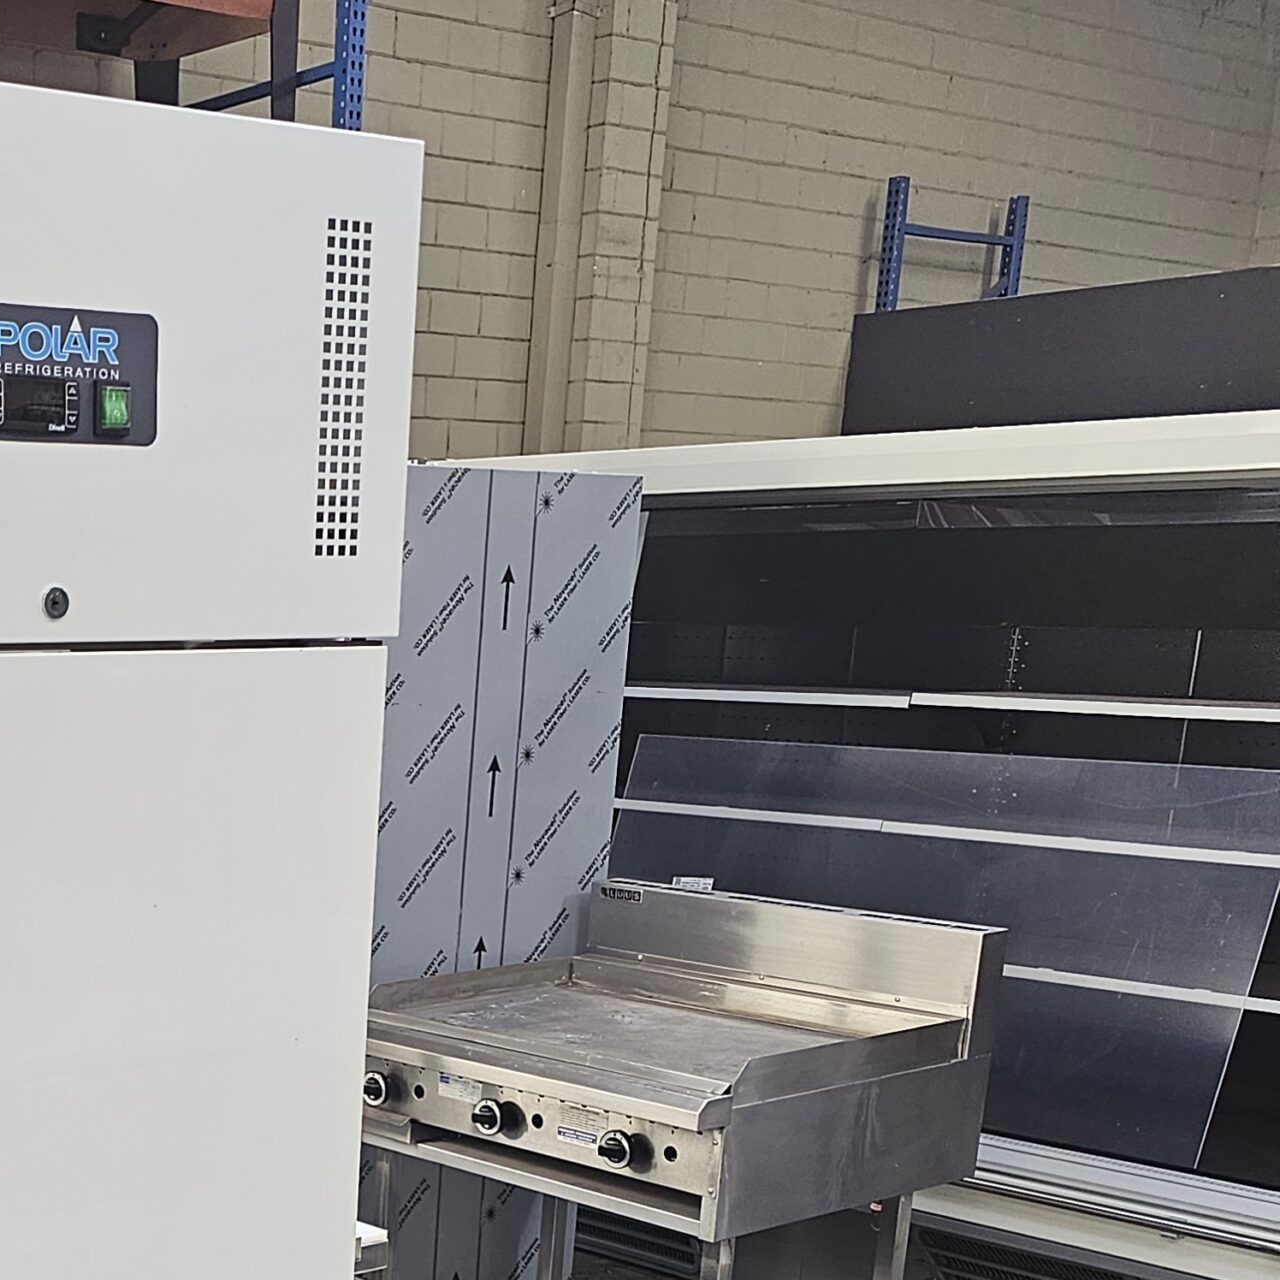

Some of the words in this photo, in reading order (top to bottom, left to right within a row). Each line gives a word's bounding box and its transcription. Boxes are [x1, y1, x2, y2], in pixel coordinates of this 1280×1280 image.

[429, 486, 445, 506] LASER
[448, 582, 463, 602] LASER
[553, 596, 567, 615] LASER
[579, 560, 592, 579] LASER
[421, 619, 436, 639] LASER
[439, 711, 455, 730] LASER
[543, 720, 557, 739] LASER
[568, 684, 582, 703] LASER
[412, 747, 428, 767] LASER
[534, 840, 547, 859] LASER
[559, 805, 572, 824] LASER
[431, 836, 445, 855] LASER
[404, 872, 419, 891] LASER
[609, 888, 641, 902] LUUS
[423, 957, 437, 975] LASER
